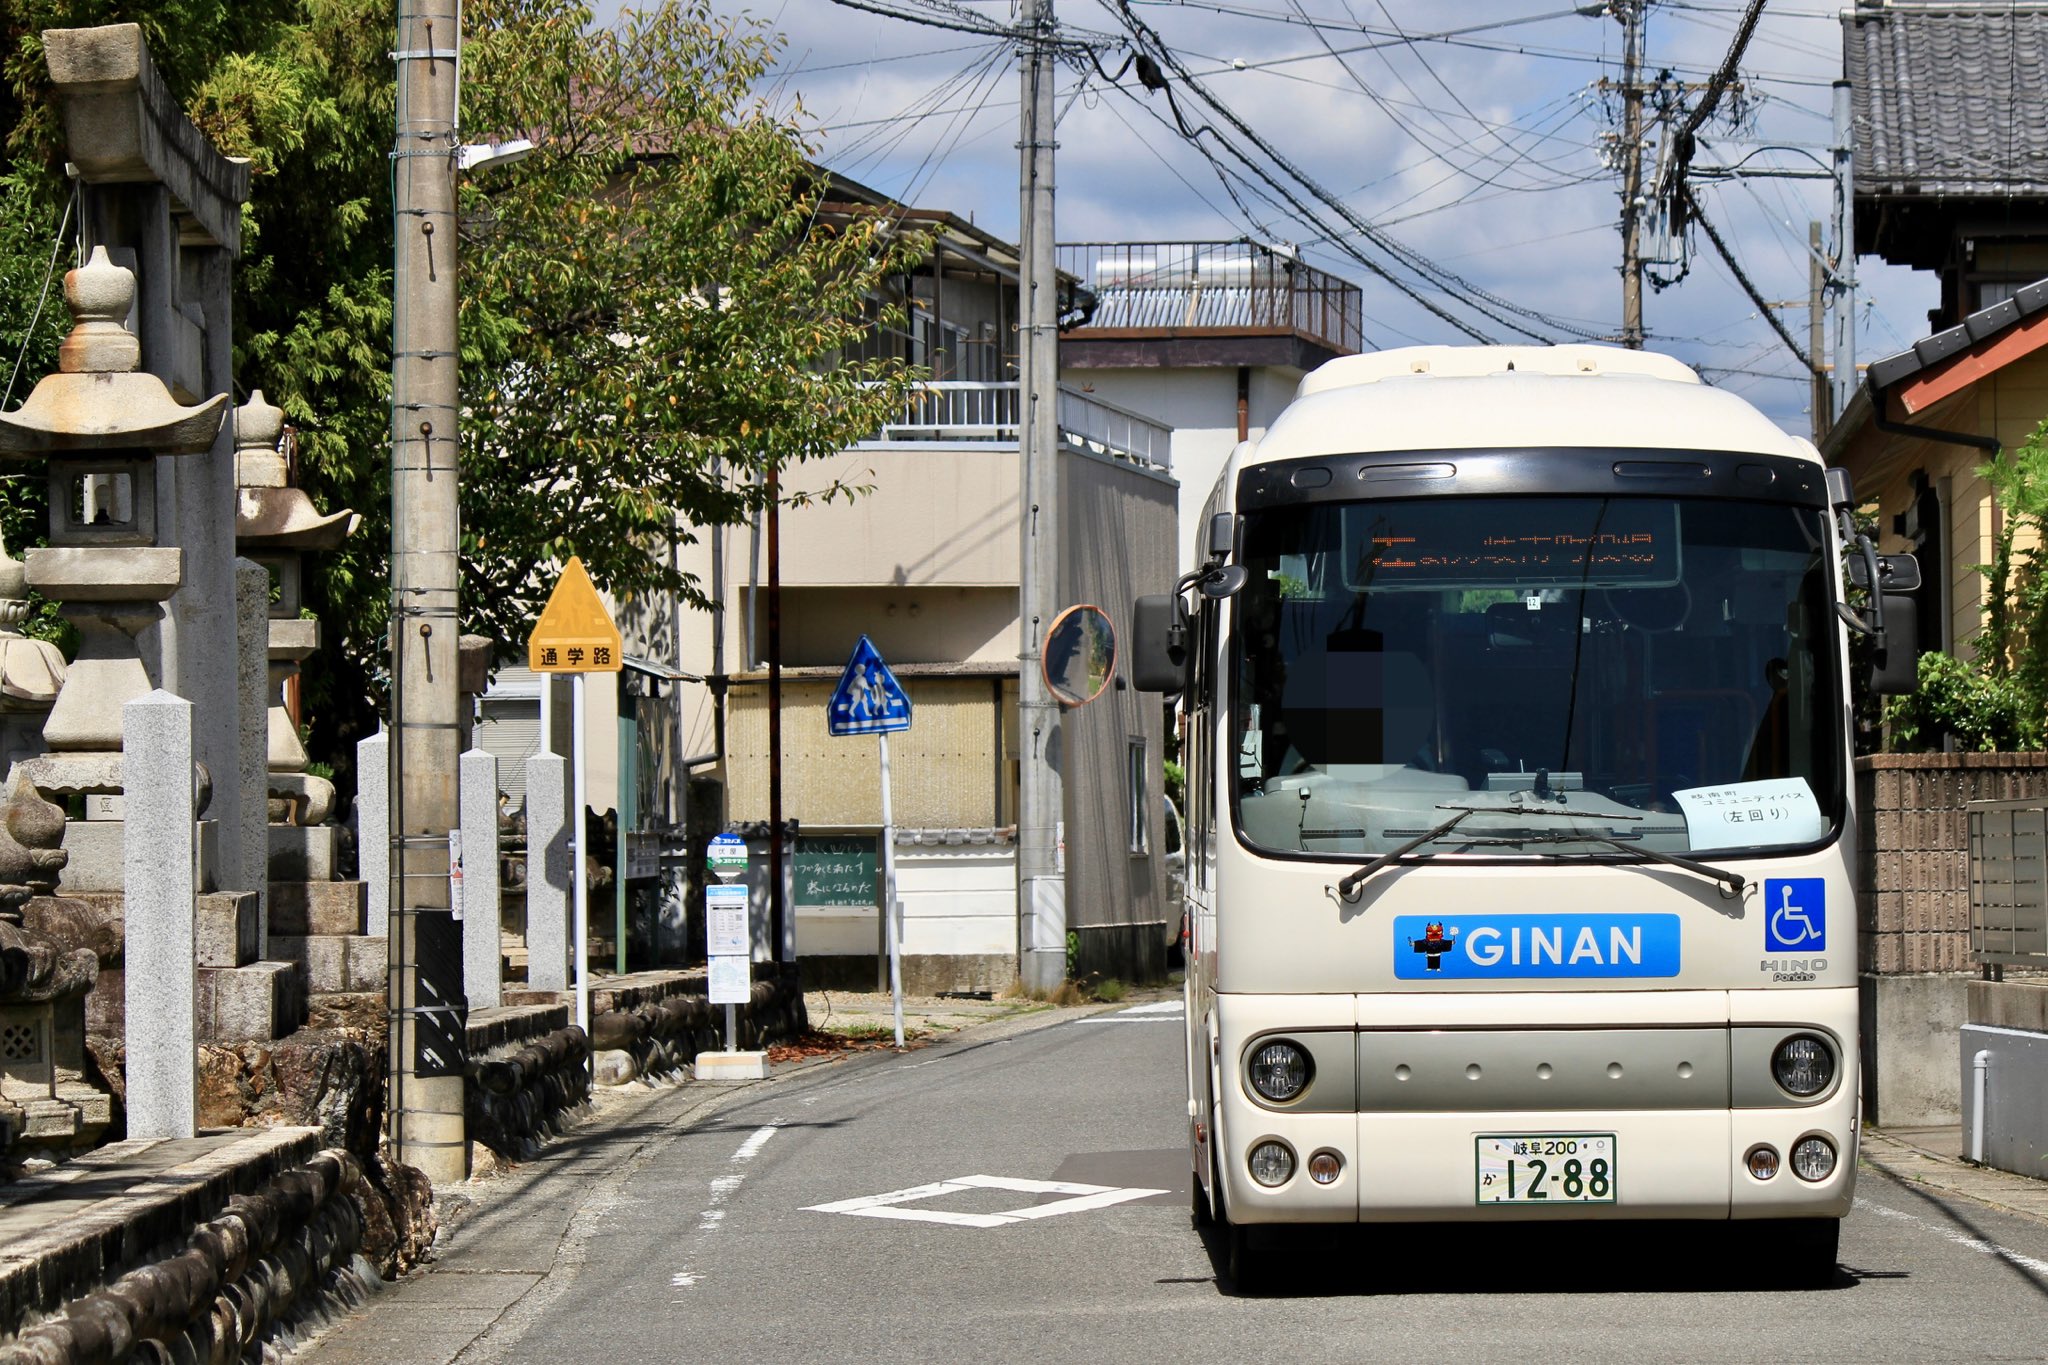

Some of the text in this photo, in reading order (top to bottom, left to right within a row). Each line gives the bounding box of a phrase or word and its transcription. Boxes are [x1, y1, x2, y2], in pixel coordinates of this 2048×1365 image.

[541, 647, 611, 666] 通学路
[1690, 790, 1737, 800] 岐南町
[1702, 792, 1805, 806] コミュニティバス
[1722, 807, 1789, 824] （左回り）
[1465, 926, 1641, 966] GINAN
[1760, 958, 1828, 972] HINO
[1483, 1158, 1609, 1198] か 12-88
